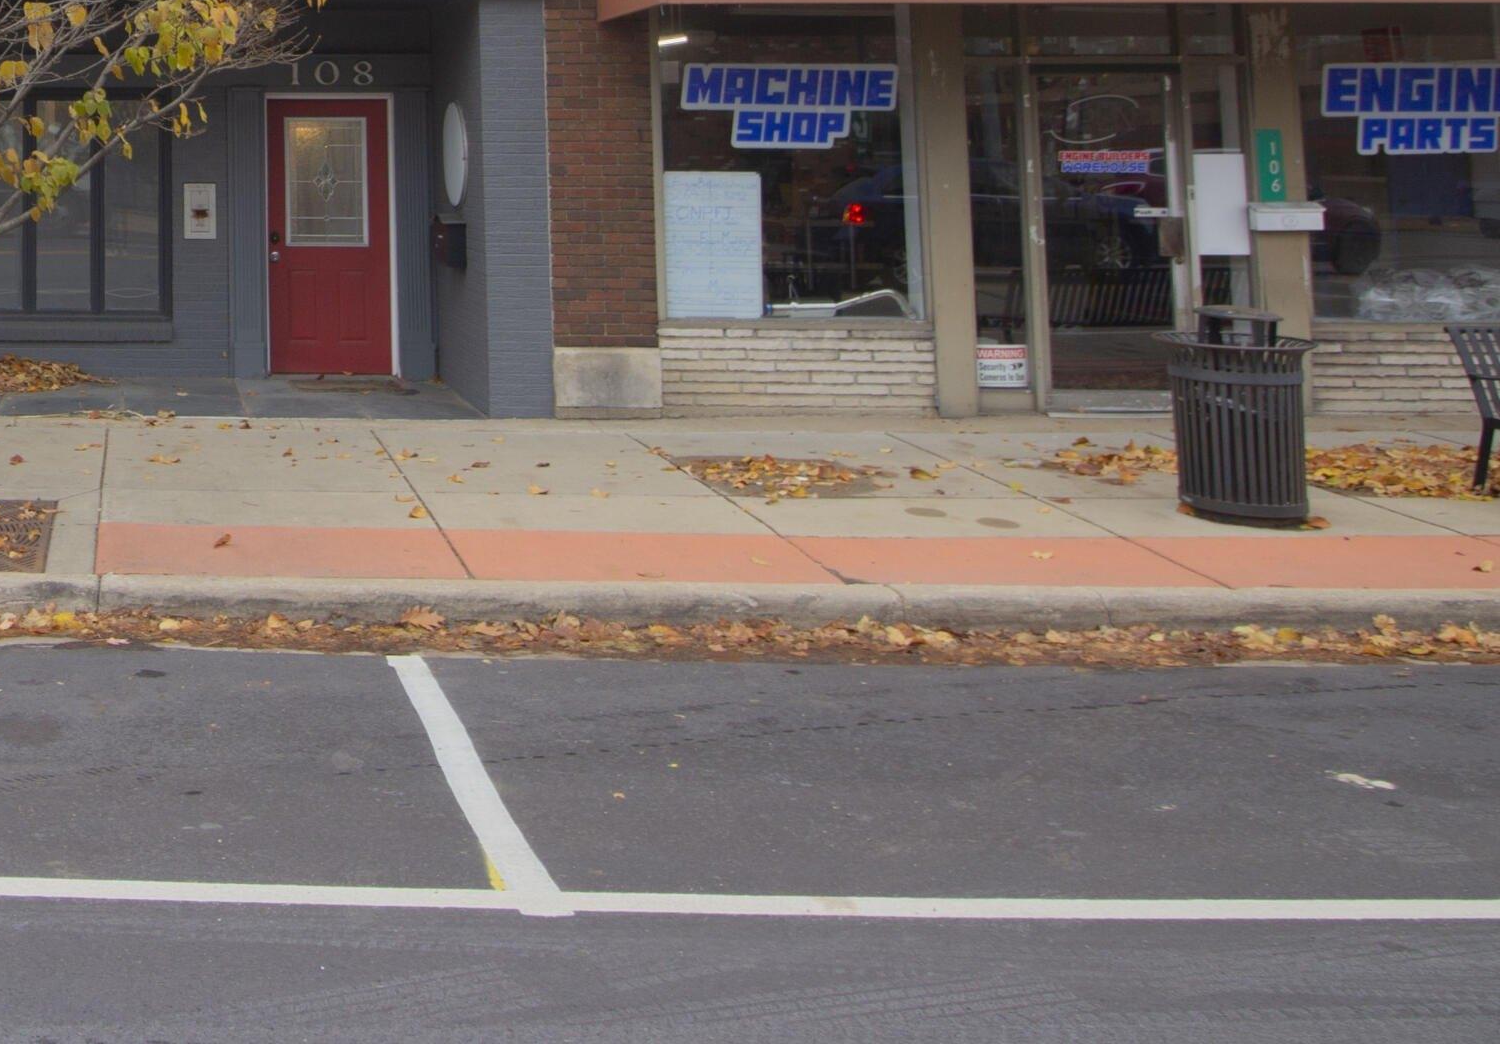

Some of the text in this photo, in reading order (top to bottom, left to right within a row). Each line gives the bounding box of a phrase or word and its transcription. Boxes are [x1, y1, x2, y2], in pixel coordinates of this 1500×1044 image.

[291, 60, 374, 86] 108
[686, 67, 895, 107] MACHINE
[1326, 67, 1500, 112] ENGIN
[736, 111, 846, 143] SHOP
[1362, 118, 1495, 150] PARTS
[1059, 150, 1095, 161] ENGINE
[1062, 162, 1147, 172] WAREHOUSE
[1268, 141, 1281, 193] 106
[977, 348, 1025, 358] WARNING
[979, 362, 1006, 372] Security
